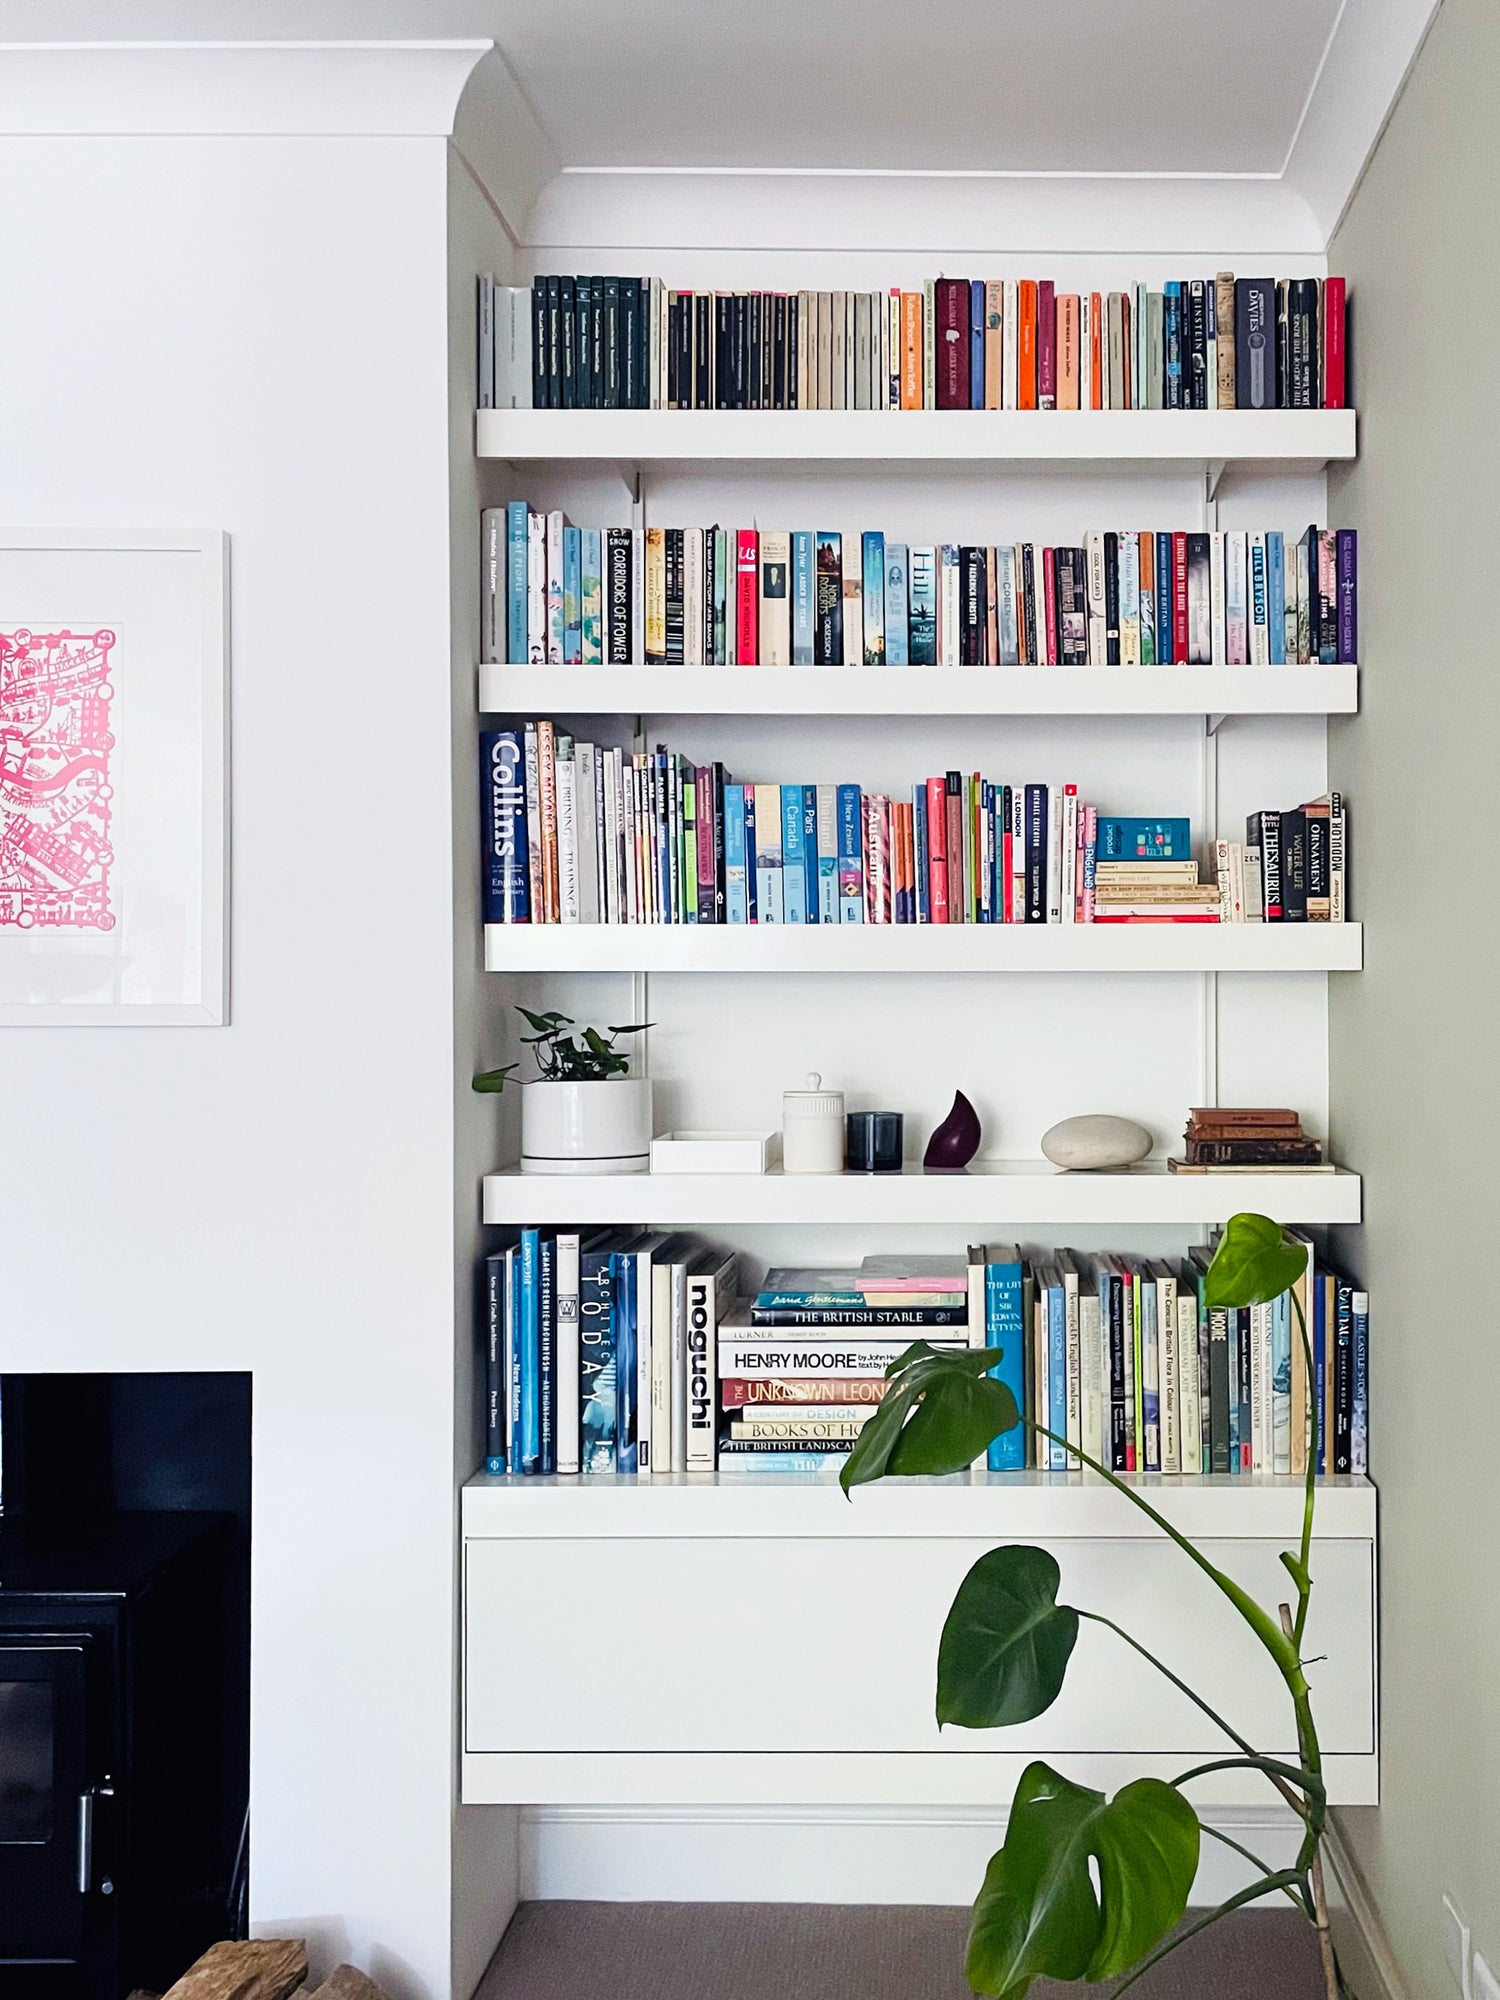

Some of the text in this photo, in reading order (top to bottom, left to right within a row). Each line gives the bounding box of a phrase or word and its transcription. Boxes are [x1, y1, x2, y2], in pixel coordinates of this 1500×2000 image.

[907, 296, 915, 320] Future
[989, 284, 1000, 310] Bez
[1248, 290, 1259, 331] DAVIES
[1194, 298, 1202, 350] EINSTEIN
[1170, 373, 1178, 404] gibson
[798, 553, 806, 568] Tyler
[1176, 538, 1184, 564] BRINGING
[914, 551, 933, 594] Hill
[1002, 552, 1011, 616] Harlan COBEN
[1177, 565, 1185, 580] DOWN
[1253, 548, 1264, 624] BILL BRYSON
[614, 549, 626, 660] CORRIDORS OF POWER
[800, 598, 806, 606] OF
[819, 577, 828, 615] ROBERTS
[828, 584, 837, 608] NORA
[1177, 594, 1185, 611] HOUSE
[1064, 639, 1074, 654] RAND
[540, 728, 553, 831] ISSEY MIYAKE
[492, 740, 524, 857] Collins
[746, 814, 754, 827] Fiji
[786, 806, 798, 849] Canada
[805, 809, 815, 834] Paris
[821, 794, 832, 848] Thailand
[562, 787, 574, 905] PRUNING TRAINING
[868, 811, 880, 885] Australia
[1294, 834, 1303, 890] WATER LIFE
[1310, 824, 1320, 893] ORNAMENT
[1332, 822, 1342, 871] MODULOR
[1084, 849, 1094, 889] ENGLAND
[1265, 829, 1280, 904] THESAURUS
[523, 1242, 532, 1284] PICASSO
[542, 1252, 550, 1288] CHARLES
[999, 1292, 1010, 1300] OF
[795, 1311, 924, 1322] THE BRITISH STABLE
[987, 1323, 1022, 1332] LUTYENS
[992, 1313, 1020, 1321] EDWIN
[1113, 1283, 1122, 1381] Discovering London's Buildings
[1211, 1312, 1226, 1341] MOORE
[1338, 1287, 1352, 1346] bauhaus
[542, 1320, 550, 1372] MACKINTOSH
[580, 1272, 602, 1404] TODAY
[688, 1285, 711, 1429] noguchi
[735, 1353, 857, 1368] HENRY MOORE
[1069, 1343, 1078, 1374] English
[542, 1379, 550, 1417] ANTHONY
[734, 1384, 744, 1400] THE
[747, 1383, 893, 1402] UNKNOWN LEON
[1069, 1376, 1078, 1420] Landscape
[1358, 1371, 1366, 1400] STORY
[489, 1409, 498, 1428] Davey
[542, 1418, 550, 1443] JONES
[752, 1424, 862, 1437] BOOKS OF HO
[729, 1441, 750, 1450] THE
[753, 1440, 798, 1450] BRITISH
